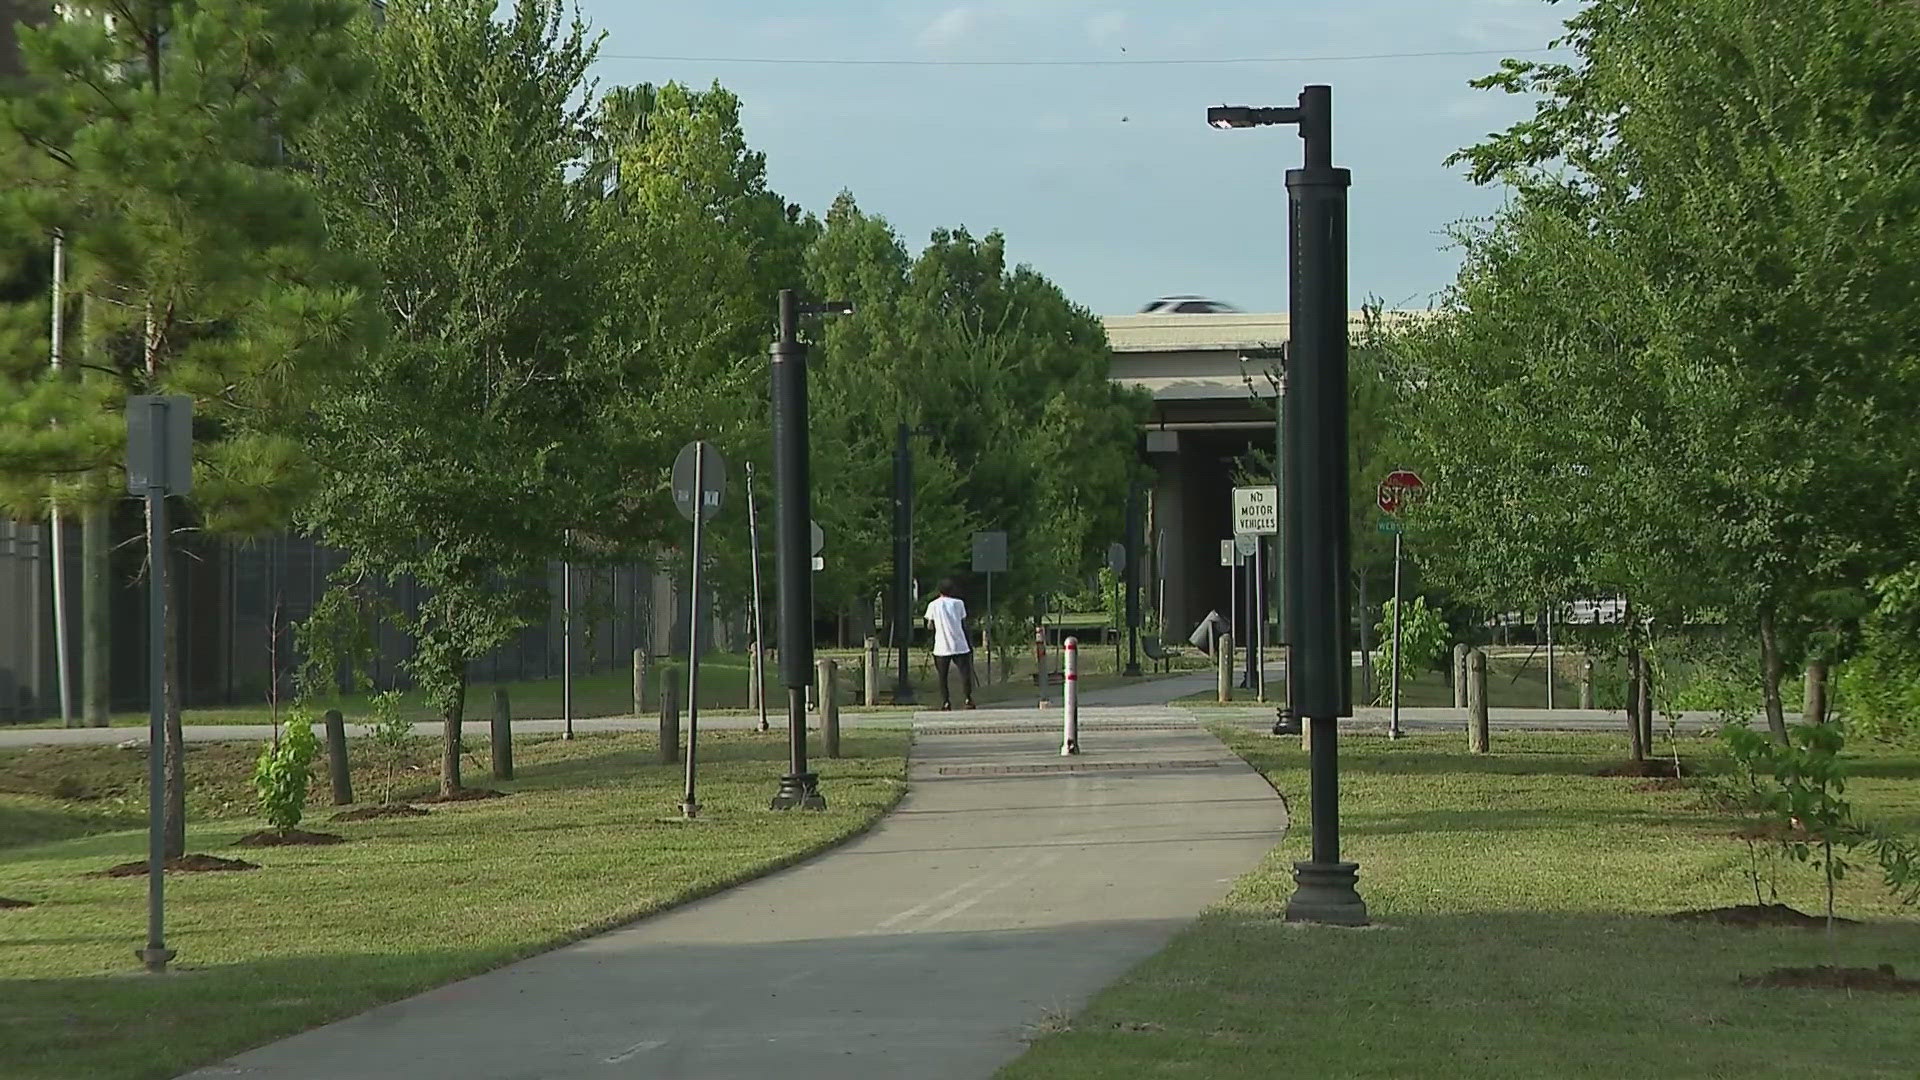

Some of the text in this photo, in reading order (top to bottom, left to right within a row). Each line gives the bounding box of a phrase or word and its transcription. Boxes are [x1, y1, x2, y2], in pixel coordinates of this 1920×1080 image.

[1250, 491, 1263, 502] NO
[1241, 505, 1273, 516] MOTOR
[1240, 519, 1275, 529] VEHICLES
